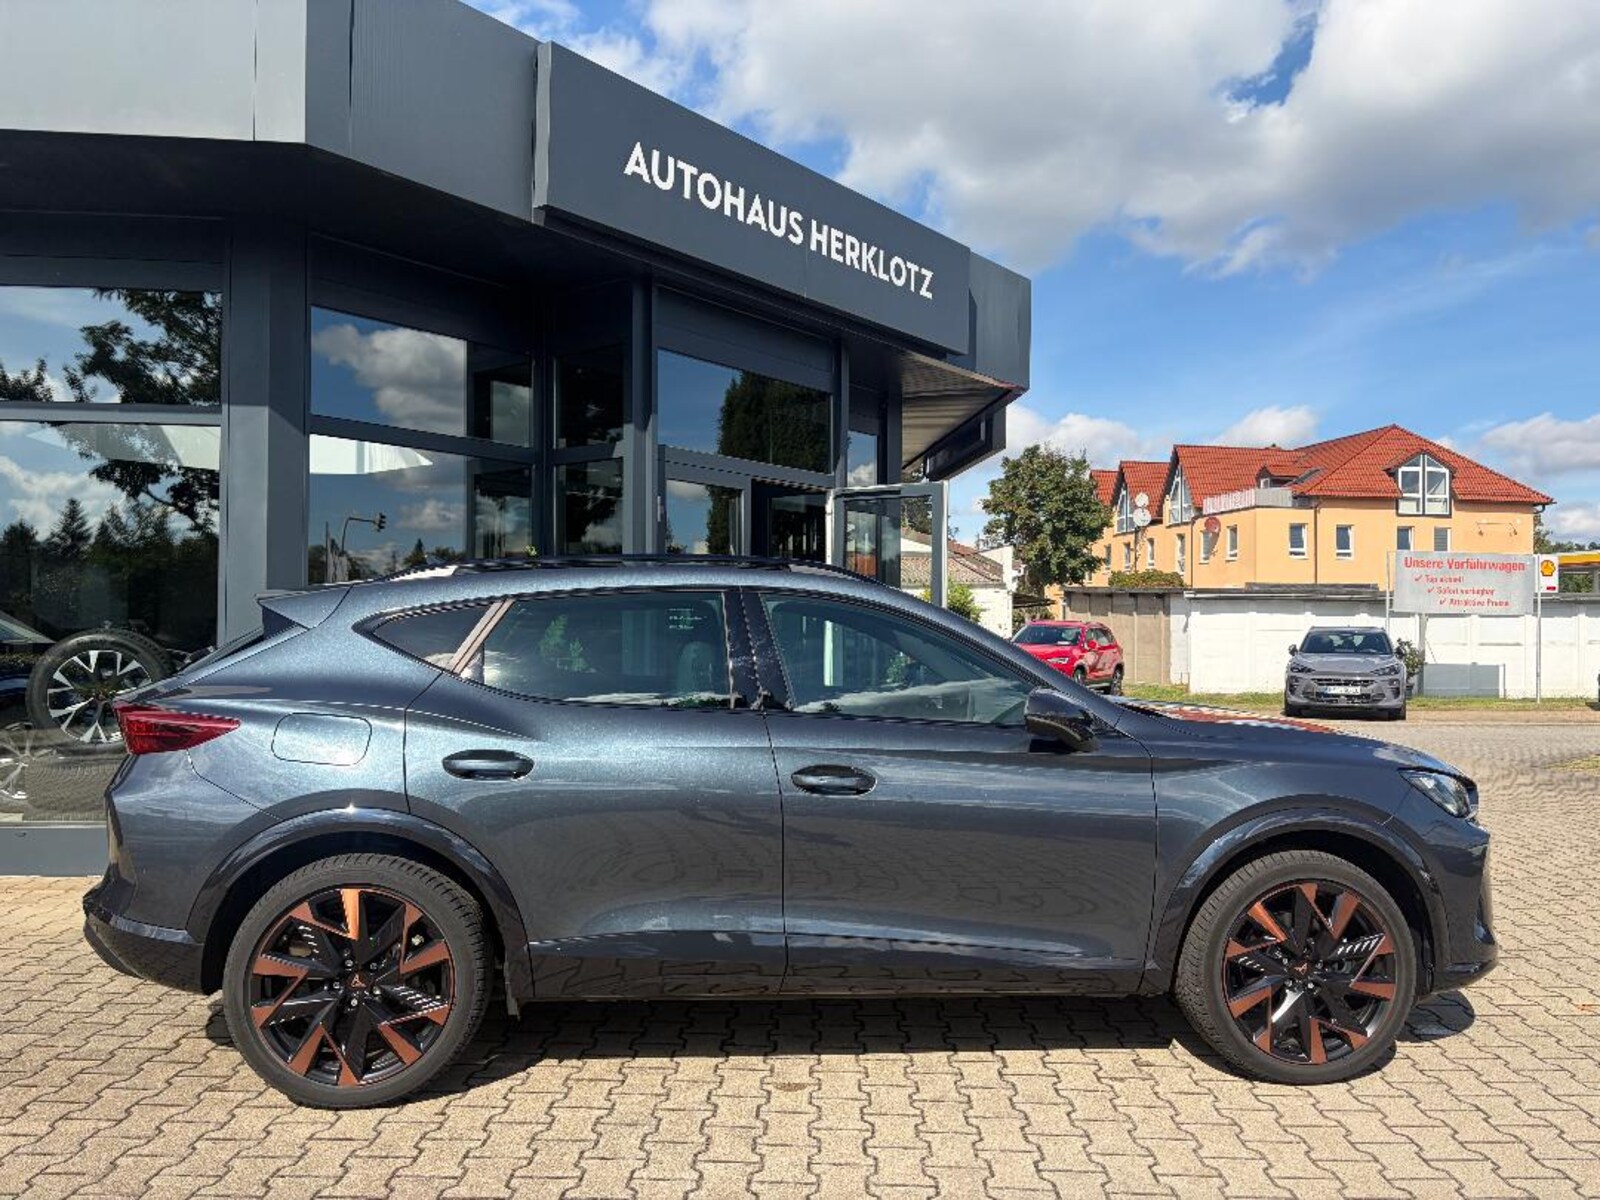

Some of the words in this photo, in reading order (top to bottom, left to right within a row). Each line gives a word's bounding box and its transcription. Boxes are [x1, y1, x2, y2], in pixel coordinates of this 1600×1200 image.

[624, 141, 803, 245] AUTOHAUS
[810, 219, 934, 300] HERKLOTZ
[1404, 556, 1444, 569] Unsere
[1447, 557, 1526, 574] Vorführwagen
[1436, 586, 1458, 594] Sofort
